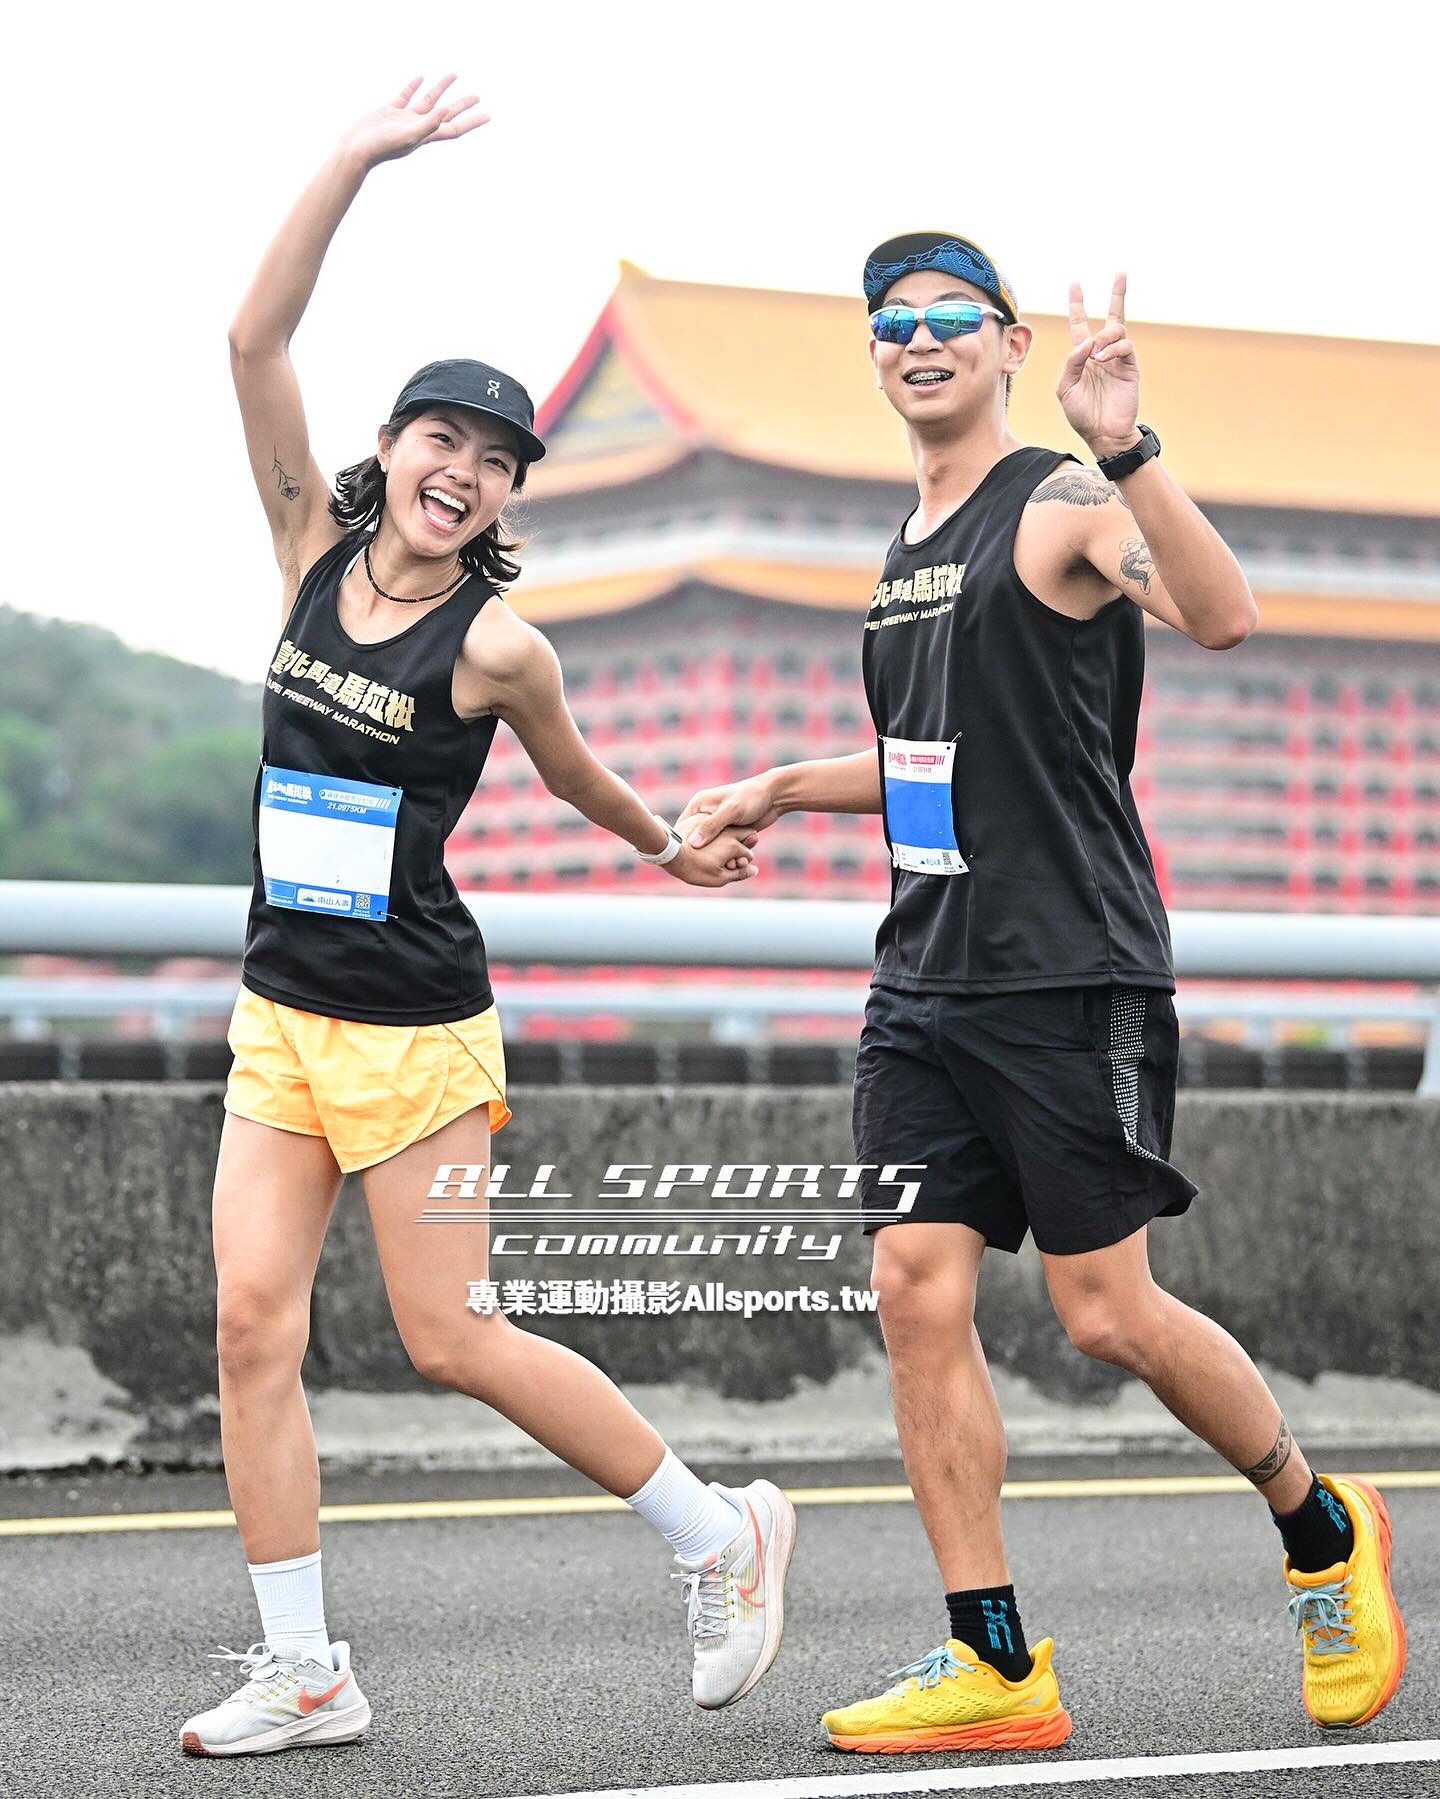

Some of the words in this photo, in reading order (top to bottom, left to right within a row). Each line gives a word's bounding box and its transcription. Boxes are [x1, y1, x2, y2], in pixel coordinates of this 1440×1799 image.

[880, 611, 920, 629] FREEWAY
[282, 687, 335, 716] FREEWAY
[332, 711, 401, 745] MARATHON
